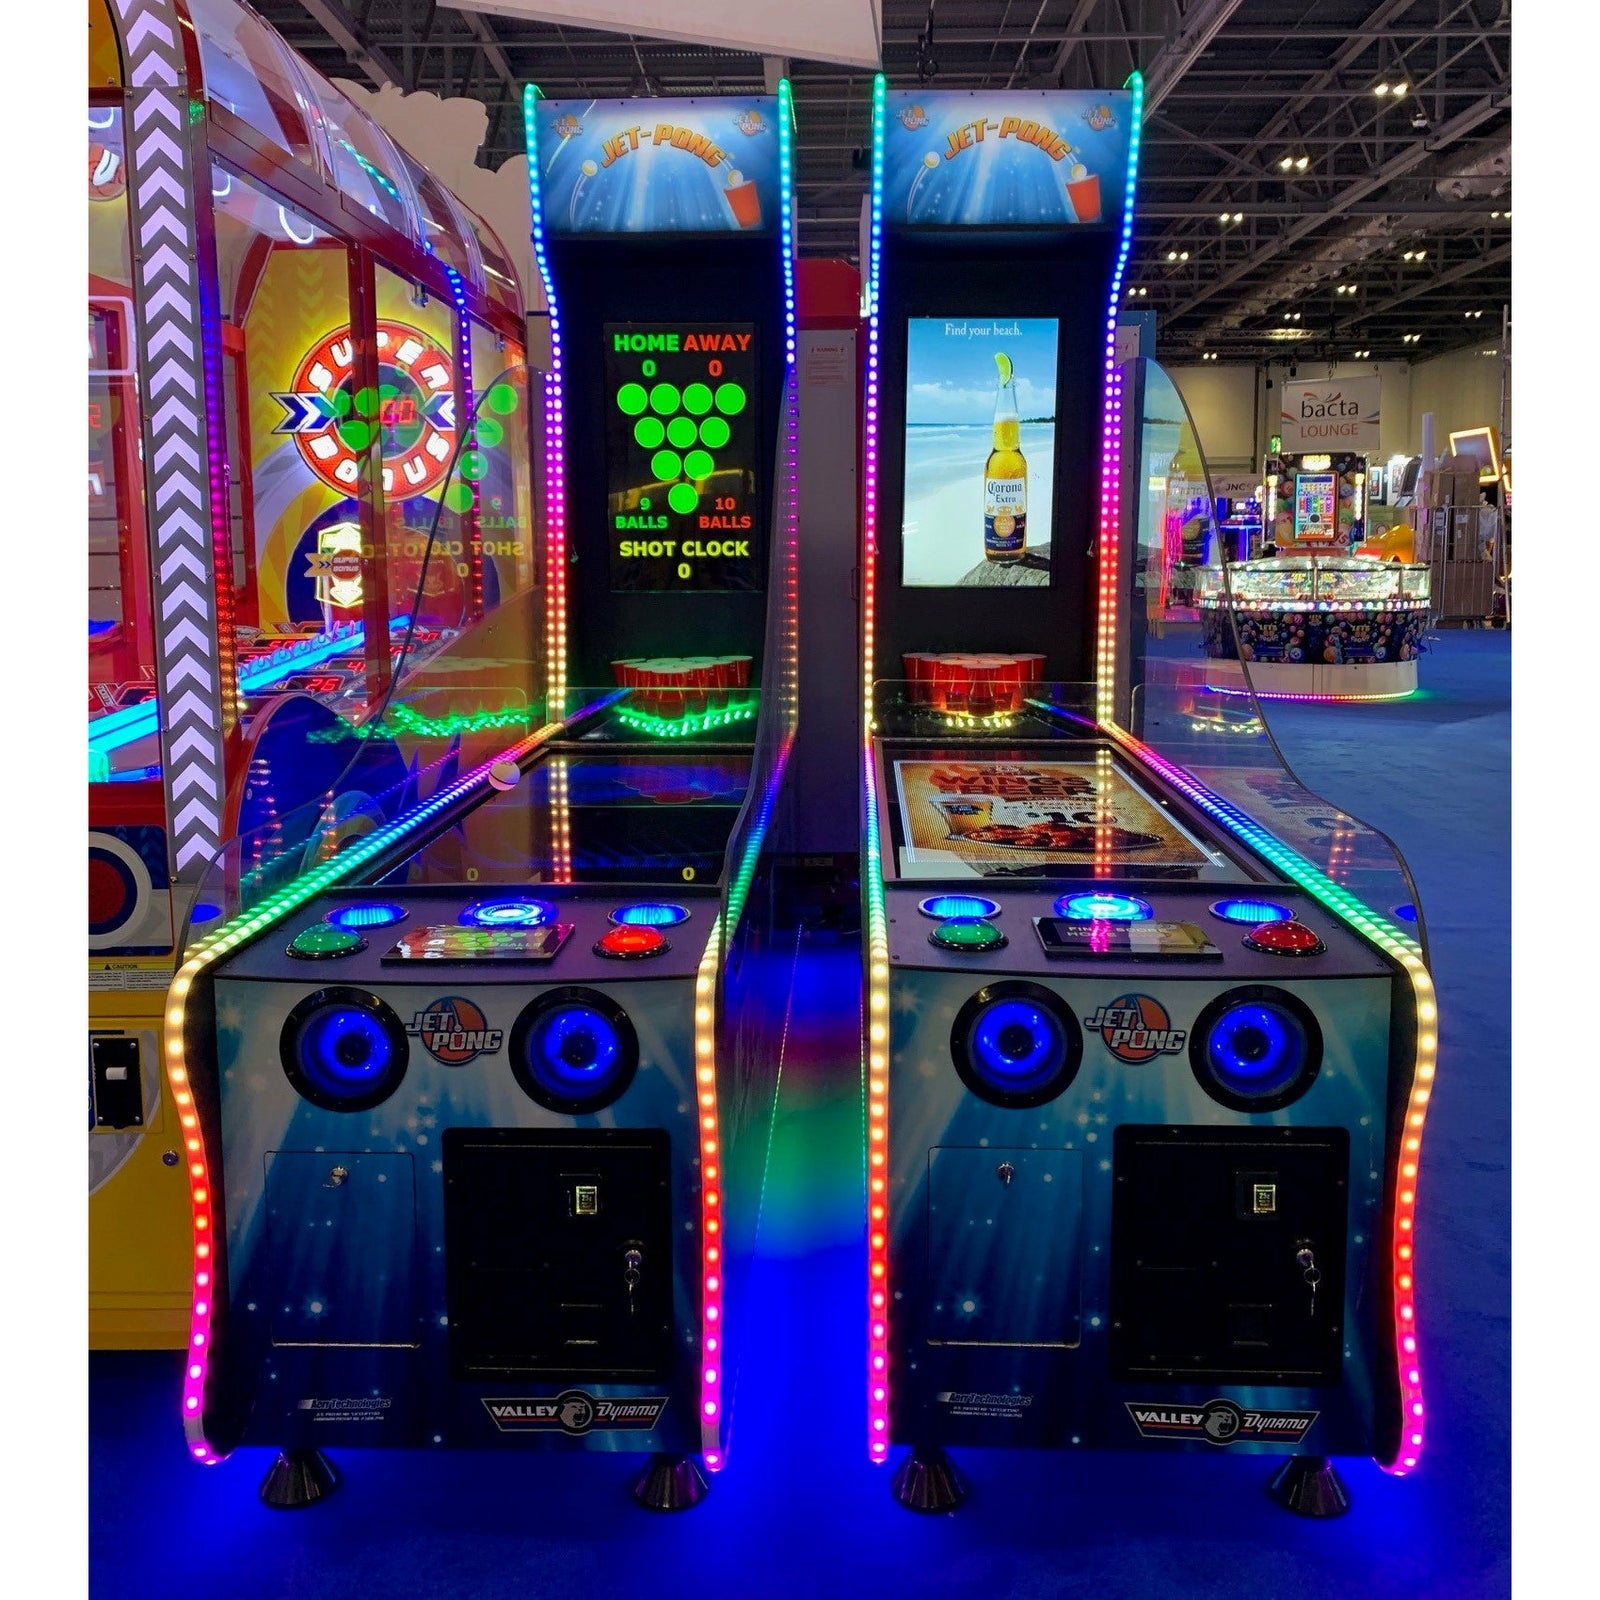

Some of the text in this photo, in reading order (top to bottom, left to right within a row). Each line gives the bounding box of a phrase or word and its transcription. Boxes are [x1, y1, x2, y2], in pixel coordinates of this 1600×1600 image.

[945, 322, 1023, 340] Find your beach.
[614, 334, 751, 351] HOME AWAY
[642, 359, 723, 377] 0 0
[1301, 400, 1359, 418] bacta
[1301, 423, 1359, 438] LOUNGE
[987, 480, 1022, 494] Corona
[640, 497, 735, 511] 9 10
[995, 494, 1017, 503] Extra
[615, 516, 751, 529] BALLS BALLS
[619, 541, 750, 557] SHOT CLOCK
[677, 563, 691, 579] 0
[937, 776, 1091, 786] WINGS
[404, 1012, 454, 1032] JET
[1084, 1008, 1137, 1028] JET
[431, 1031, 503, 1051] PONG
[1110, 1029, 1186, 1050] PONG
[491, 1406, 559, 1417] VALLEY
[1135, 1411, 1204, 1425] VALLEY
